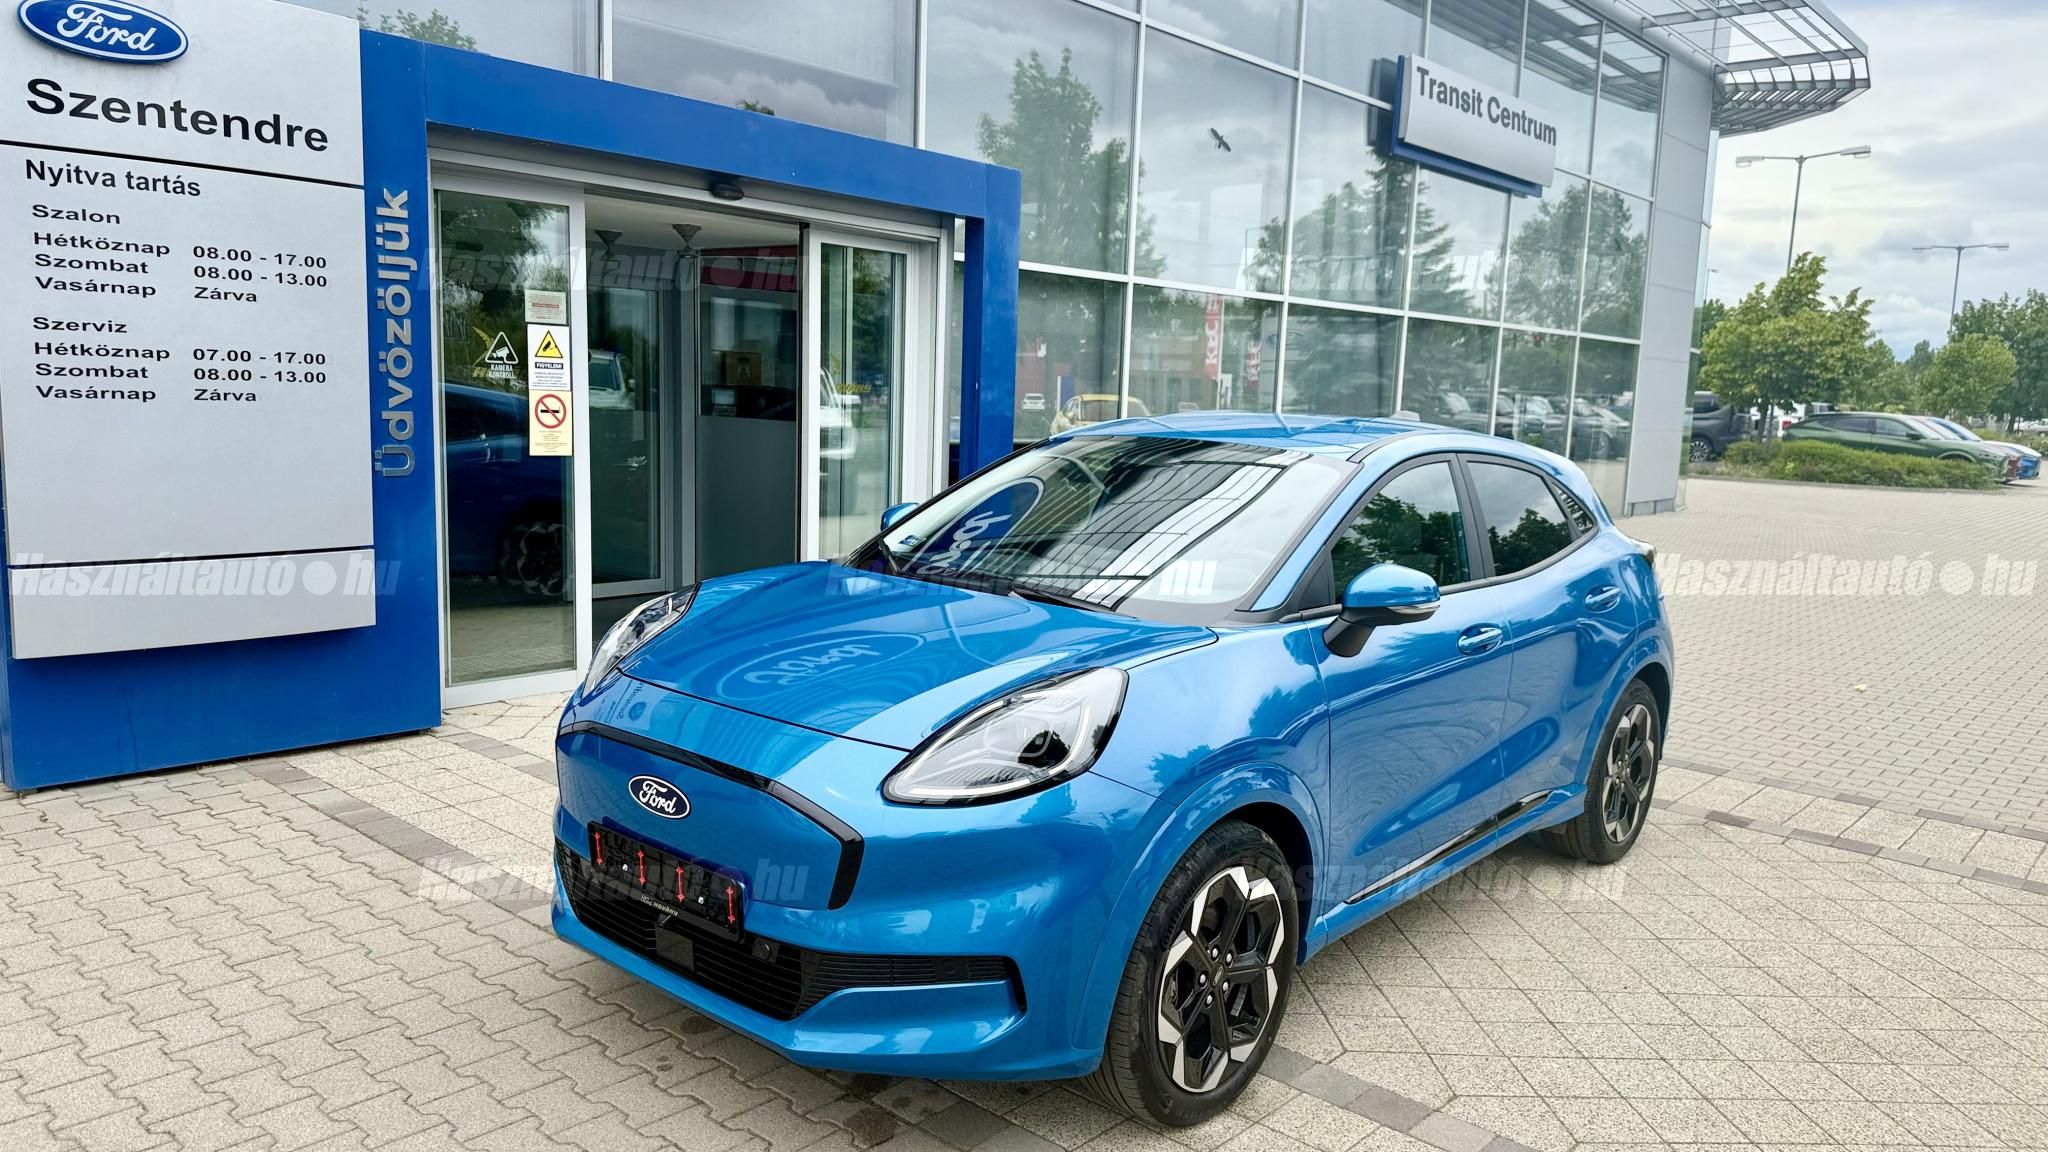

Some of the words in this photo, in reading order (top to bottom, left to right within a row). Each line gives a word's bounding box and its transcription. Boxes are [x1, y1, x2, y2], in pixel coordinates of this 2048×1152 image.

[56, 3, 156, 52] Ford
[26, 78, 329, 152] Szentendre
[1416, 66, 1483, 118] Transit
[1486, 96, 1557, 147] Centrum
[26, 159, 116, 187] Nyitva
[125, 170, 201, 197] tartás
[32, 204, 121, 225] Szalon
[34, 232, 170, 257] Hétköznap
[192, 245, 252, 262] 08.00
[273, 253, 327, 269] 17.00
[34, 253, 149, 274] Szombat
[193, 265, 253, 281] 08.00
[274, 272, 327, 287] 13.00
[35, 275, 156, 298] Vasárnap
[193, 286, 257, 303] Zárva
[32, 317, 128, 333] Szerviz
[375, 188, 418, 477] Üdvözöljük
[34, 342, 170, 361] Hétköznap
[192, 348, 252, 362] 07.00
[273, 352, 326, 365] 17.00
[35, 363, 149, 378] Szombat
[193, 368, 252, 381] 08.00
[274, 371, 327, 384] 13.00
[35, 385, 156, 403] Vasárnap
[193, 388, 257, 402] Zárva
[639, 779, 676, 814] Ford
